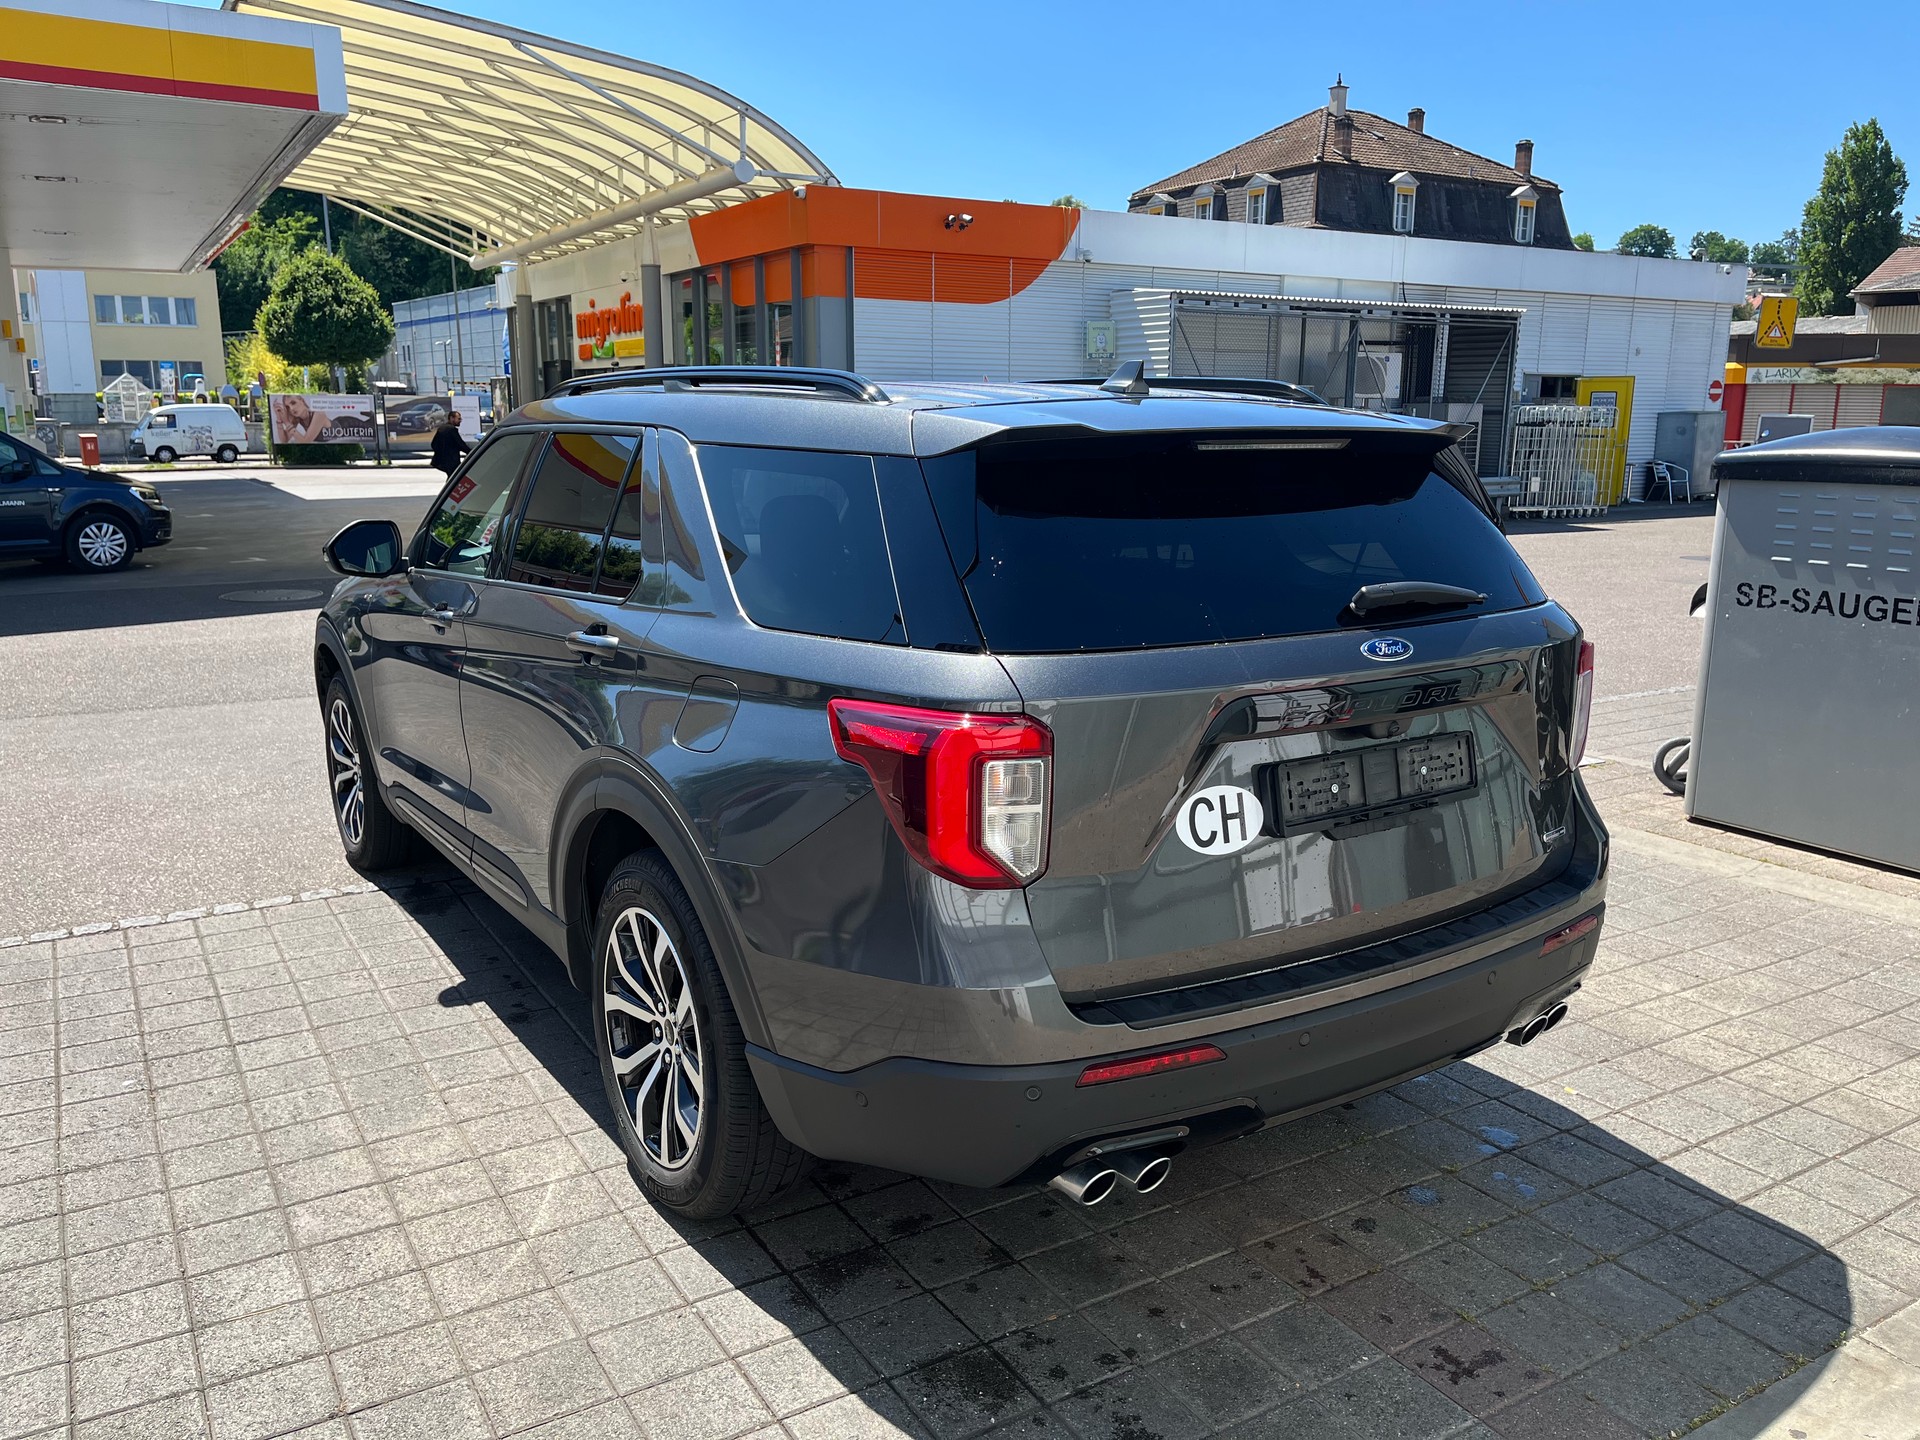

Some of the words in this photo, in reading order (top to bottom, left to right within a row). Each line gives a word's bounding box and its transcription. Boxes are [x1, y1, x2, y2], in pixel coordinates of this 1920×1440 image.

[576, 291, 644, 350] migrolin
[1765, 367, 1802, 379] LARIX
[322, 427, 374, 437] BIJOUTERIA
[1735, 582, 1920, 627] SB-SAUGE
[1375, 640, 1405, 655] Ford
[1279, 677, 1498, 731] EXPLORER
[1188, 792, 1248, 848] CH
